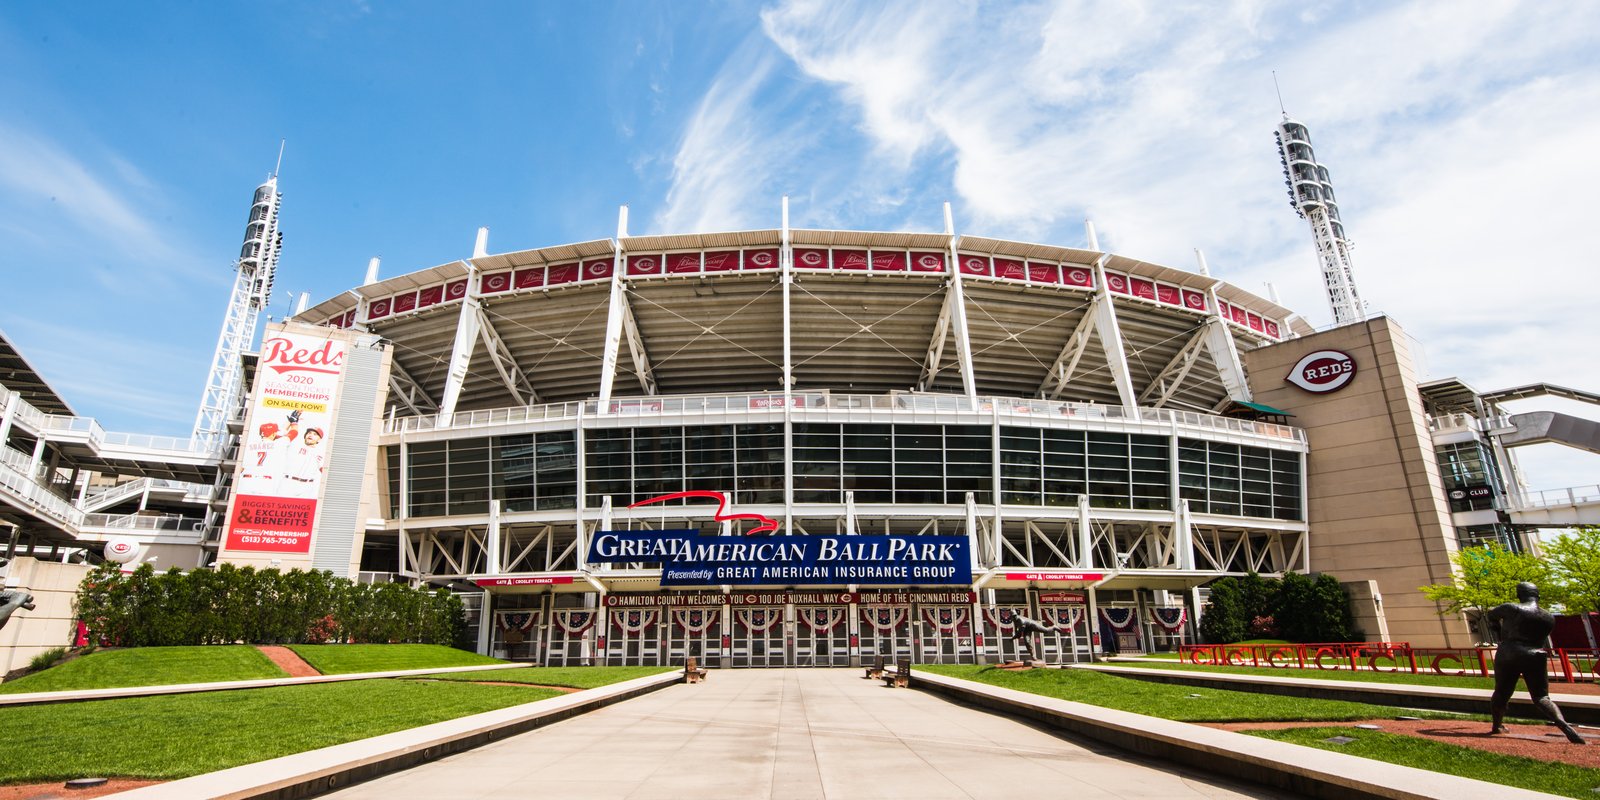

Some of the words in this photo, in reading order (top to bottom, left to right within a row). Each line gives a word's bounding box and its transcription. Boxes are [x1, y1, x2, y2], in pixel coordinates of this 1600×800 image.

[263, 337, 343, 366] Reds
[1305, 360, 1353, 380] REDS
[286, 374, 314, 385] 2020
[264, 388, 330, 401] MEMBERSHIPS
[281, 401, 299, 409] SALE
[300, 403, 323, 411] NOW!
[257, 451, 267, 466] 7
[277, 503, 311, 511] SAVINGS
[237, 508, 252, 524] &
[255, 510, 309, 519] EXCLUSIVE
[254, 516, 308, 527] BENEFITS
[262, 537, 297, 545] 765-7500
[596, 534, 682, 557] GREAT
[674, 539, 806, 562] AMERICAN
[817, 538, 883, 561] BALL
[887, 538, 955, 561] PARK
[667, 569, 702, 579] Presented
[702, 569, 713, 580] by
[717, 567, 757, 578] GREAT
[763, 567, 829, 578] AMERICAN
[836, 567, 908, 578] INSURANCE
[914, 567, 956, 578] GROUP
[619, 596, 655, 605] HAMILTON
[657, 596, 685, 605] COUNTY
[687, 595, 727, 604] WELCOMES
[730, 595, 744, 604] YOU
[759, 595, 772, 604] 100
[774, 595, 786, 603] JOE
[789, 594, 821, 603] NUXHALL
[823, 594, 839, 603] WAY
[861, 594, 881, 603] HOME
[883, 594, 892, 603] OF
[894, 594, 907, 603] THE
[909, 593, 949, 603] CINCINNATI
[951, 593, 970, 603] REDS
